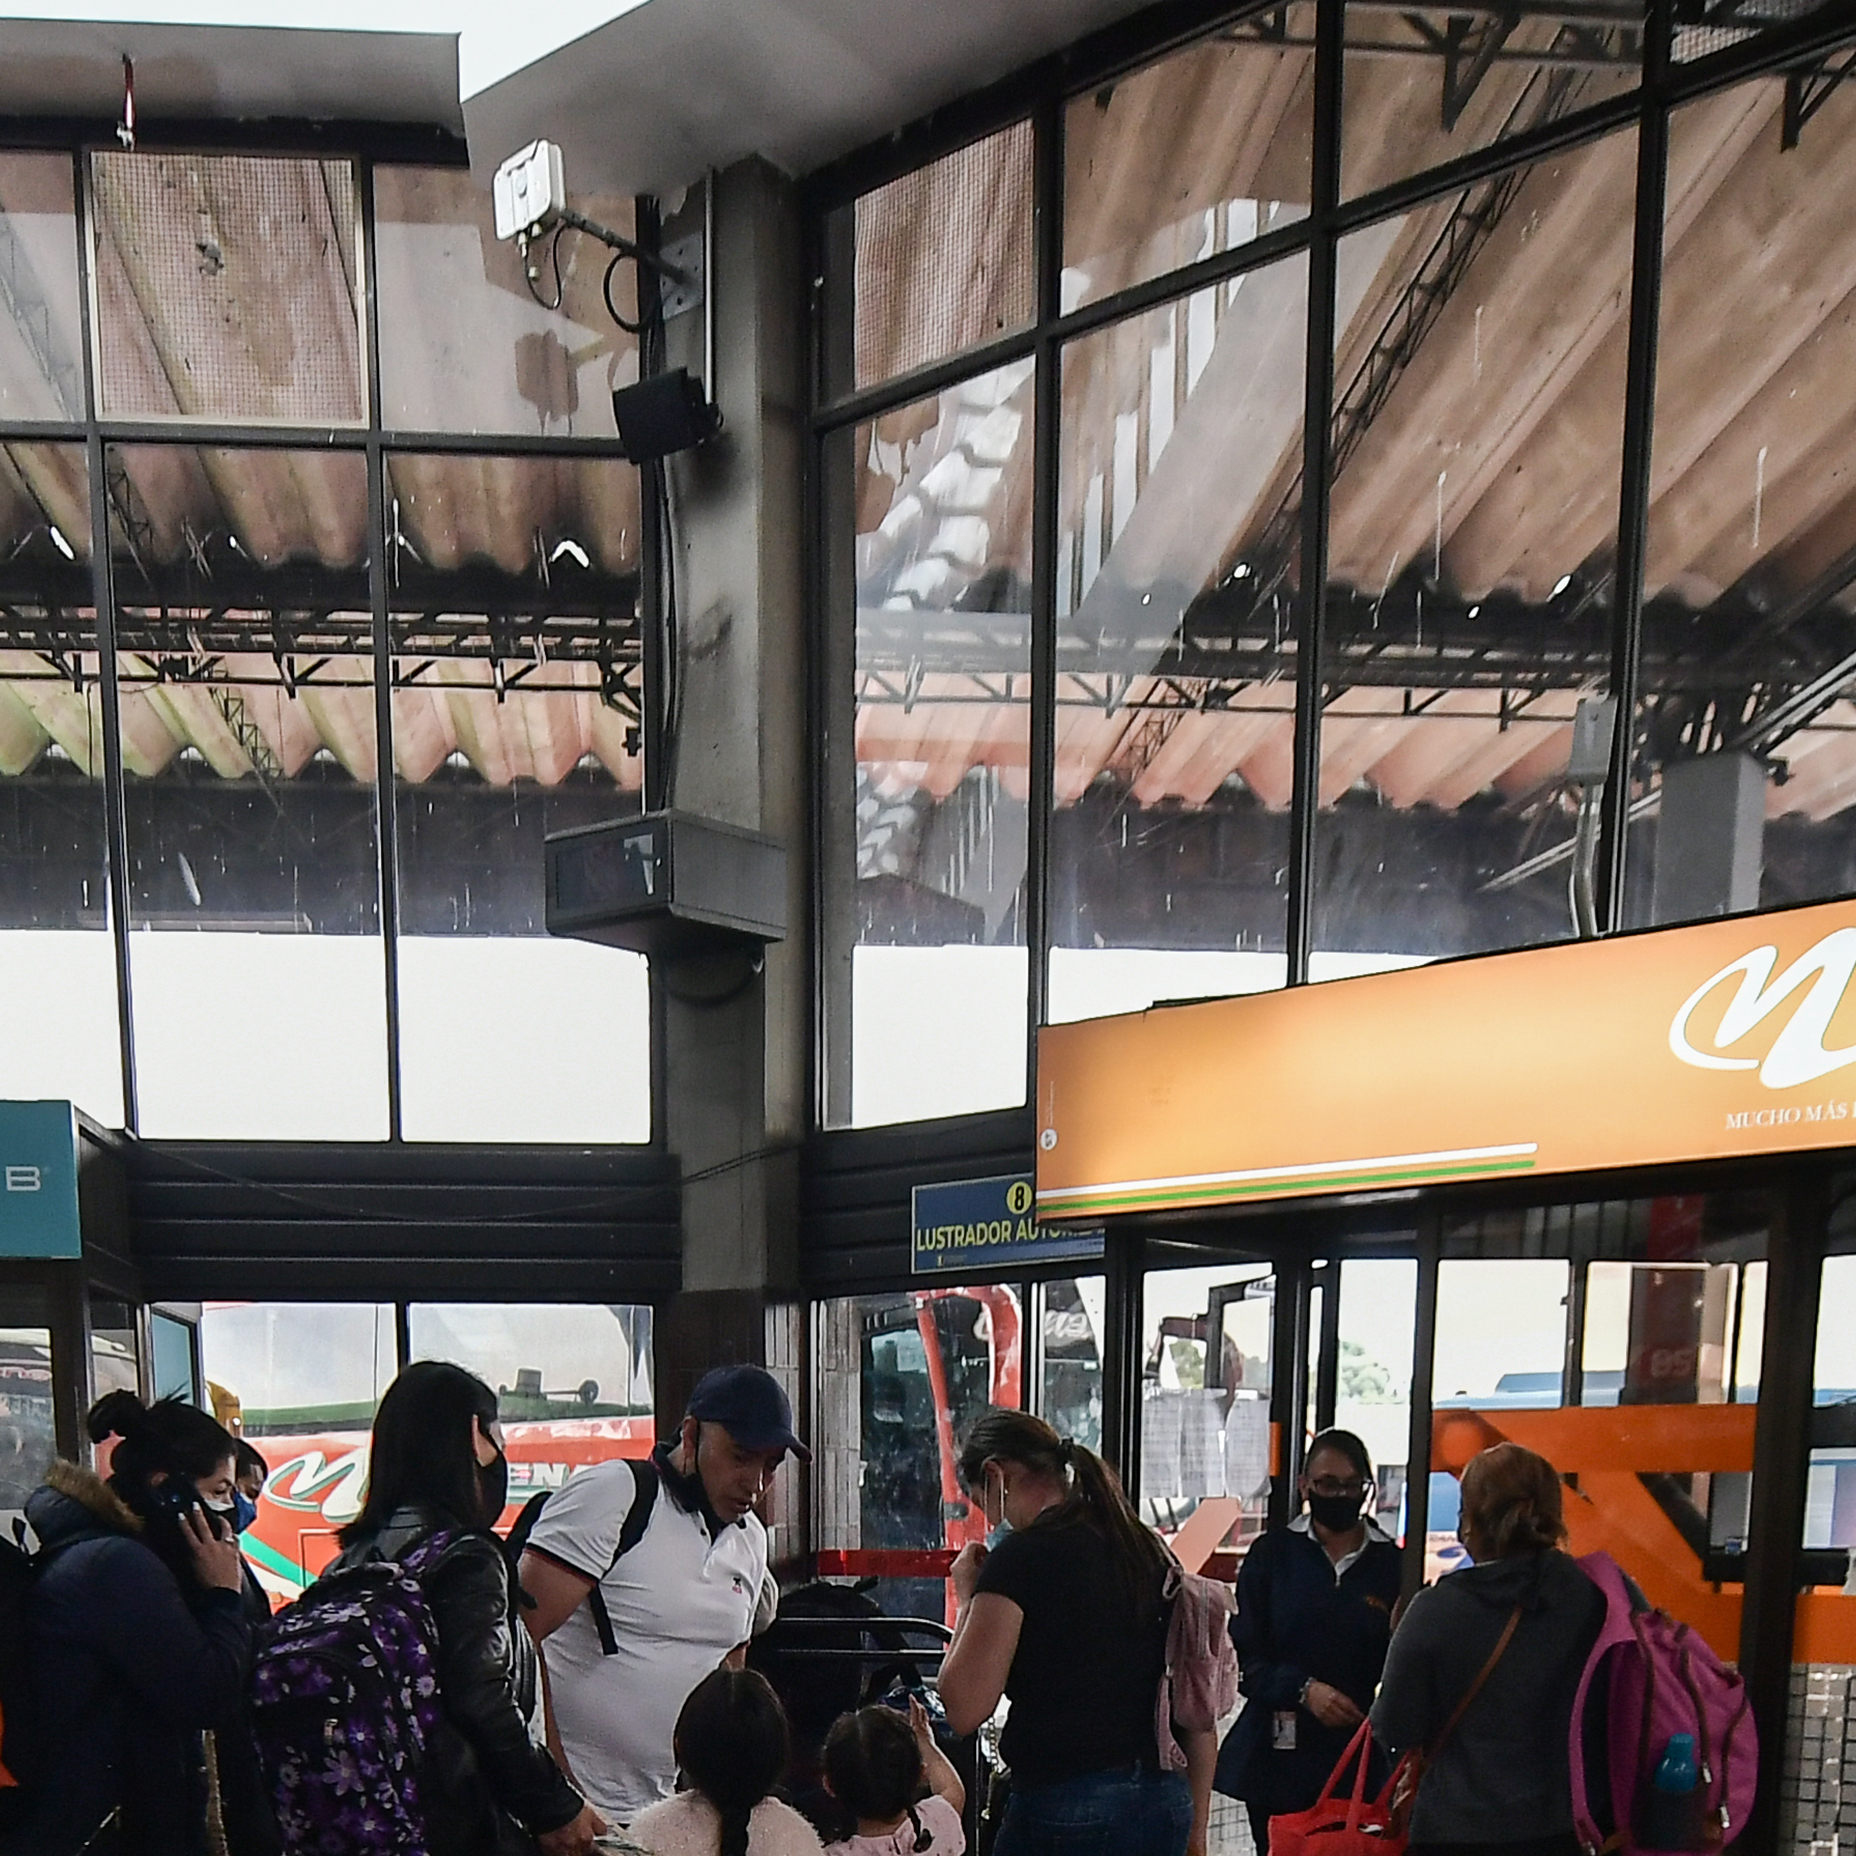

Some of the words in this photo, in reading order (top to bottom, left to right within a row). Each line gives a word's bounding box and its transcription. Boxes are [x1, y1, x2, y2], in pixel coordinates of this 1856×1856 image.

[1725, 1108, 1801, 1131] MUCHO
[1805, 1099, 1847, 1123] MÁS
[1014, 1186, 1025, 1211] 8
[916, 1221, 1012, 1251] LUSTRADOR
